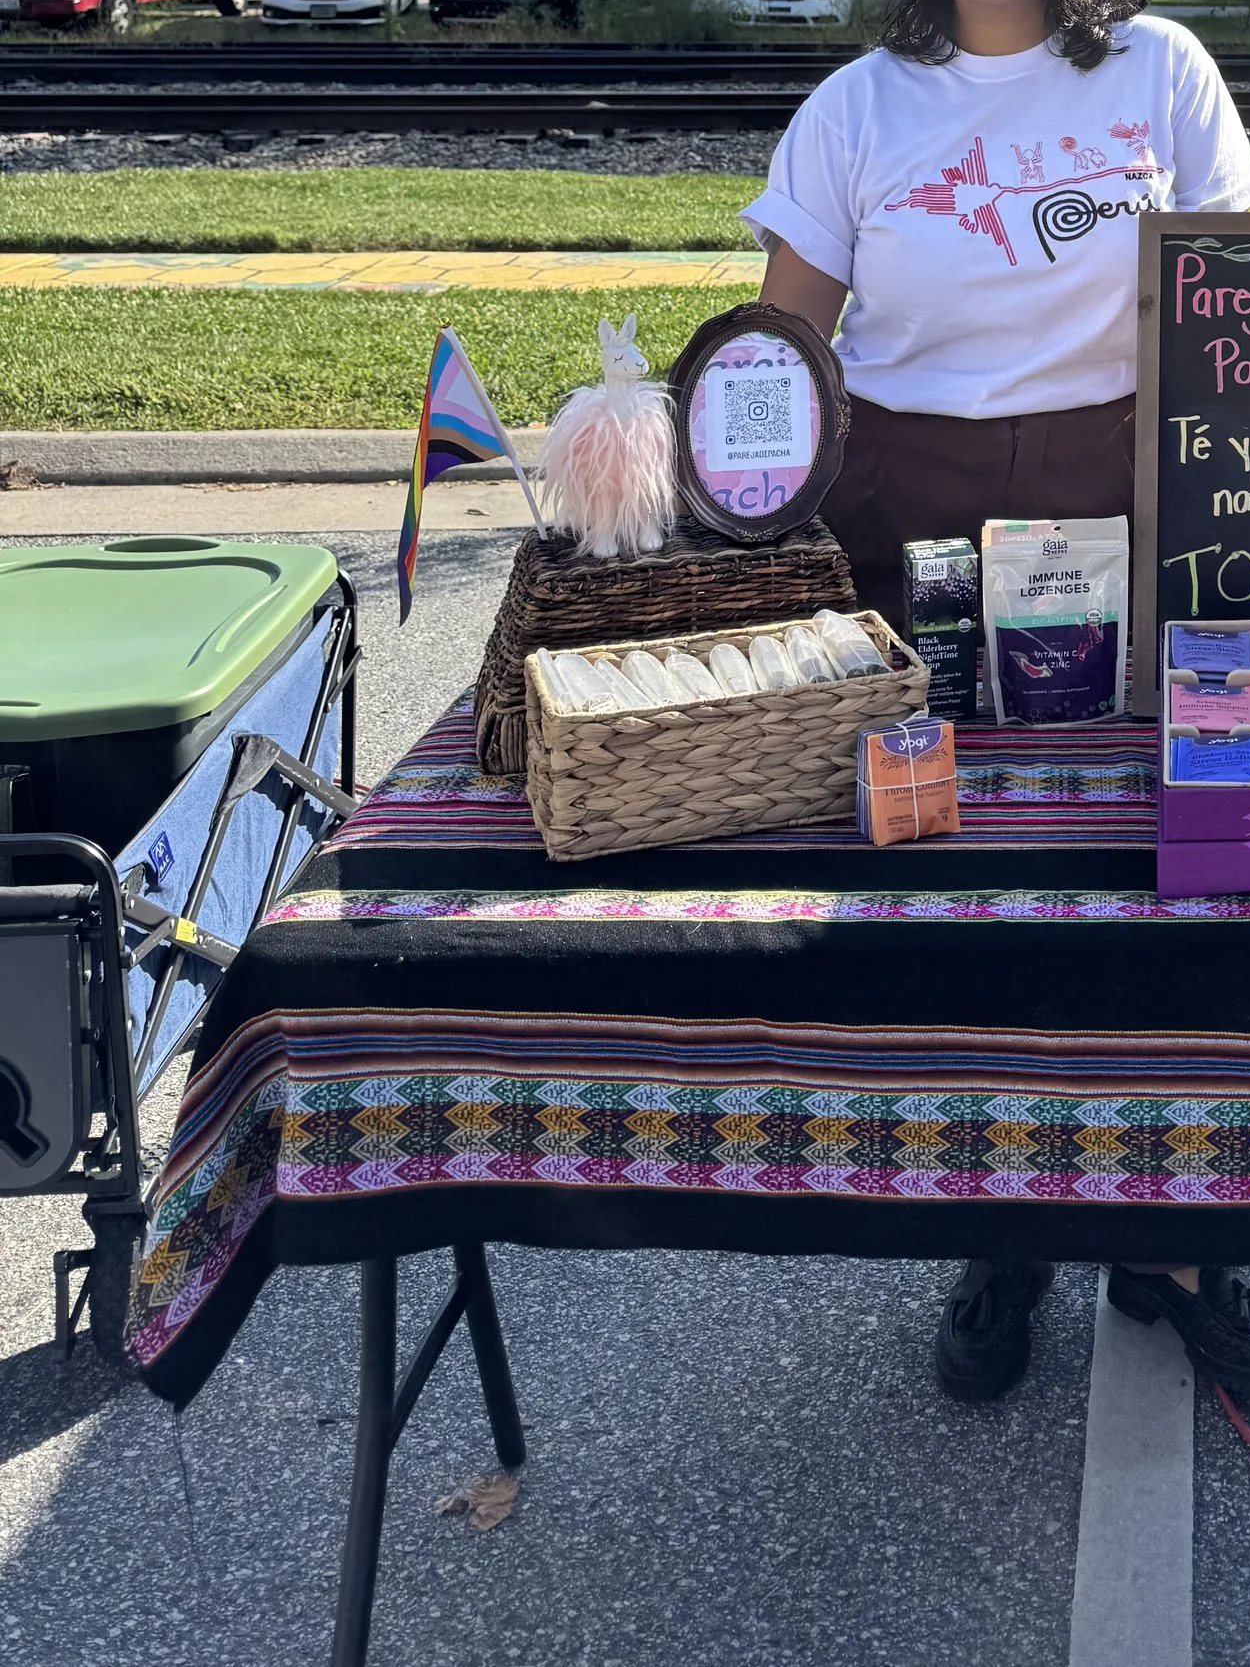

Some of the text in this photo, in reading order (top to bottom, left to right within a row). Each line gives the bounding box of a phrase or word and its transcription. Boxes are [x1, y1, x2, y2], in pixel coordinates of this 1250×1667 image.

[1125, 172, 1153, 181] NAZCA
[1168, 415, 1212, 464] Té
[1228, 438, 1250, 472] y
[728, 449, 791, 460] @PAREJADEPACHA
[699, 470, 801, 511] ach
[1042, 540, 1068, 556] gaia
[921, 562, 944, 578] gaia
[1028, 570, 1083, 585] IMMUNE
[1020, 583, 1091, 597] LOZENGES
[918, 636, 939, 645] Black
[918, 643, 958, 653] Elderberry
[918, 652, 959, 662] NightTime
[1034, 651, 1069, 659] VITAMIN
[1050, 661, 1071, 669] ZINC
[898, 735, 927, 751] yogi
[1208, 737, 1239, 745] yogi
[1189, 757, 1222, 765] Stress
